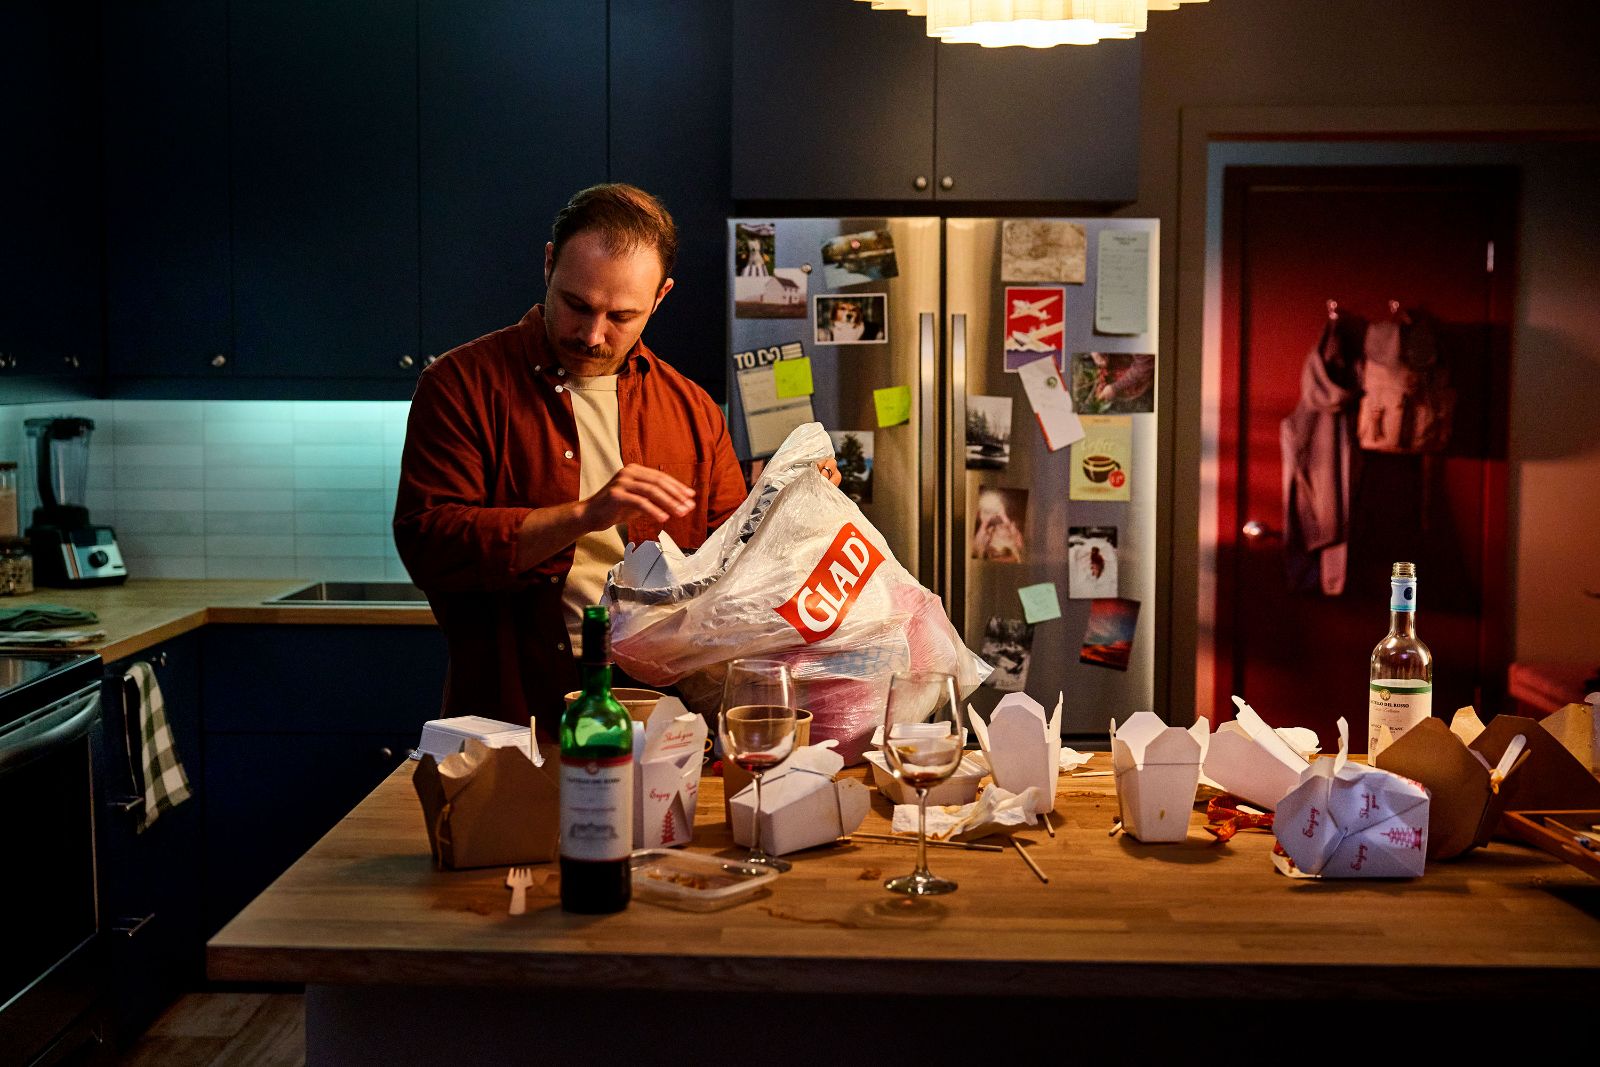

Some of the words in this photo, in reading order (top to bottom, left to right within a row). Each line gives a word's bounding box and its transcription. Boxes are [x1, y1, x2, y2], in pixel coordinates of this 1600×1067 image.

[733, 351, 755, 369] TO
[797, 536, 870, 633] GLAD
[649, 788, 671, 801] Enjoy
[1360, 792, 1370, 819] Thank
[1302, 807, 1321, 838] Enjoy
[1351, 843, 1368, 871] Enjoy
